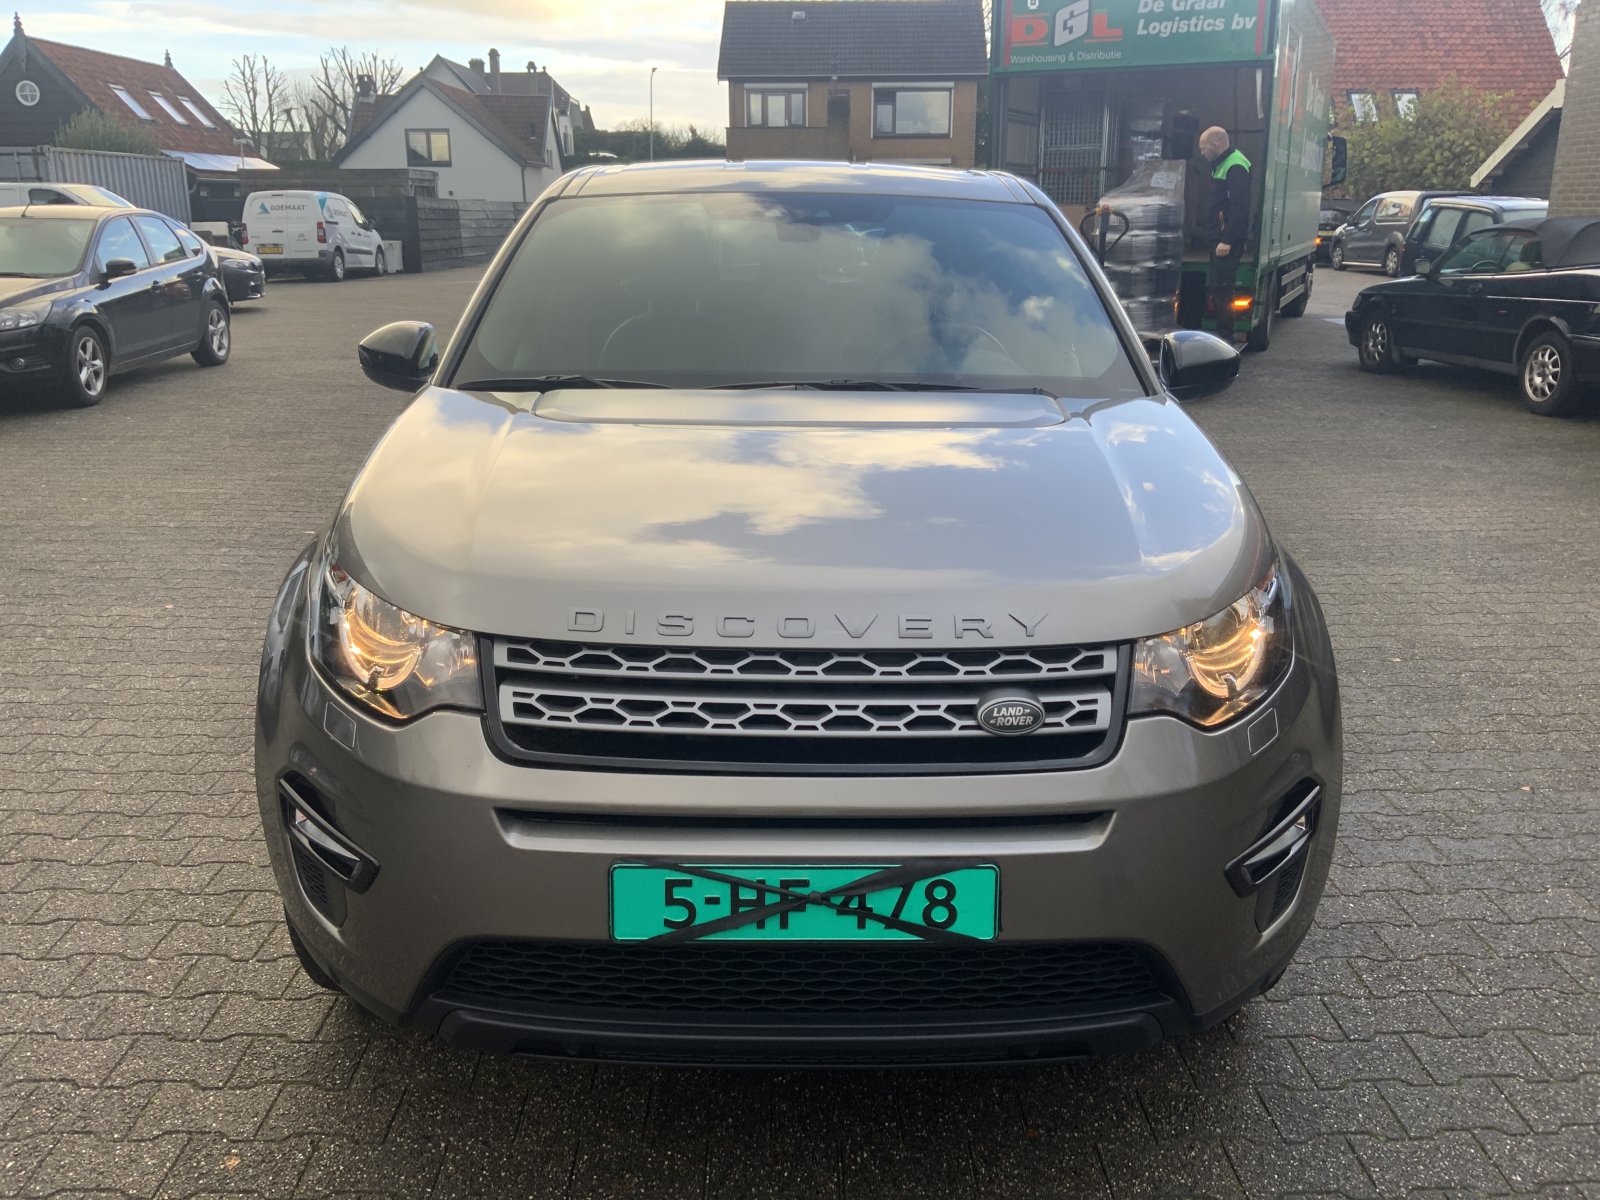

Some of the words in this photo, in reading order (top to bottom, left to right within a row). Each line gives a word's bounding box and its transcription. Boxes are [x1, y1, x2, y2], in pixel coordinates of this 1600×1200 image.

[1011, 0, 1124, 47] DGL
[1136, 16, 1226, 38] Logistics
[1231, 13, 1258, 30] bv
[1010, 53, 1066, 64] Warehousing
[1069, 52, 1075, 61] &
[1077, 50, 1122, 61] Distributie
[567, 607, 1049, 639] DISCOVERY
[993, 706, 1024, 717] LAND
[996, 716, 1034, 726] ROVER
